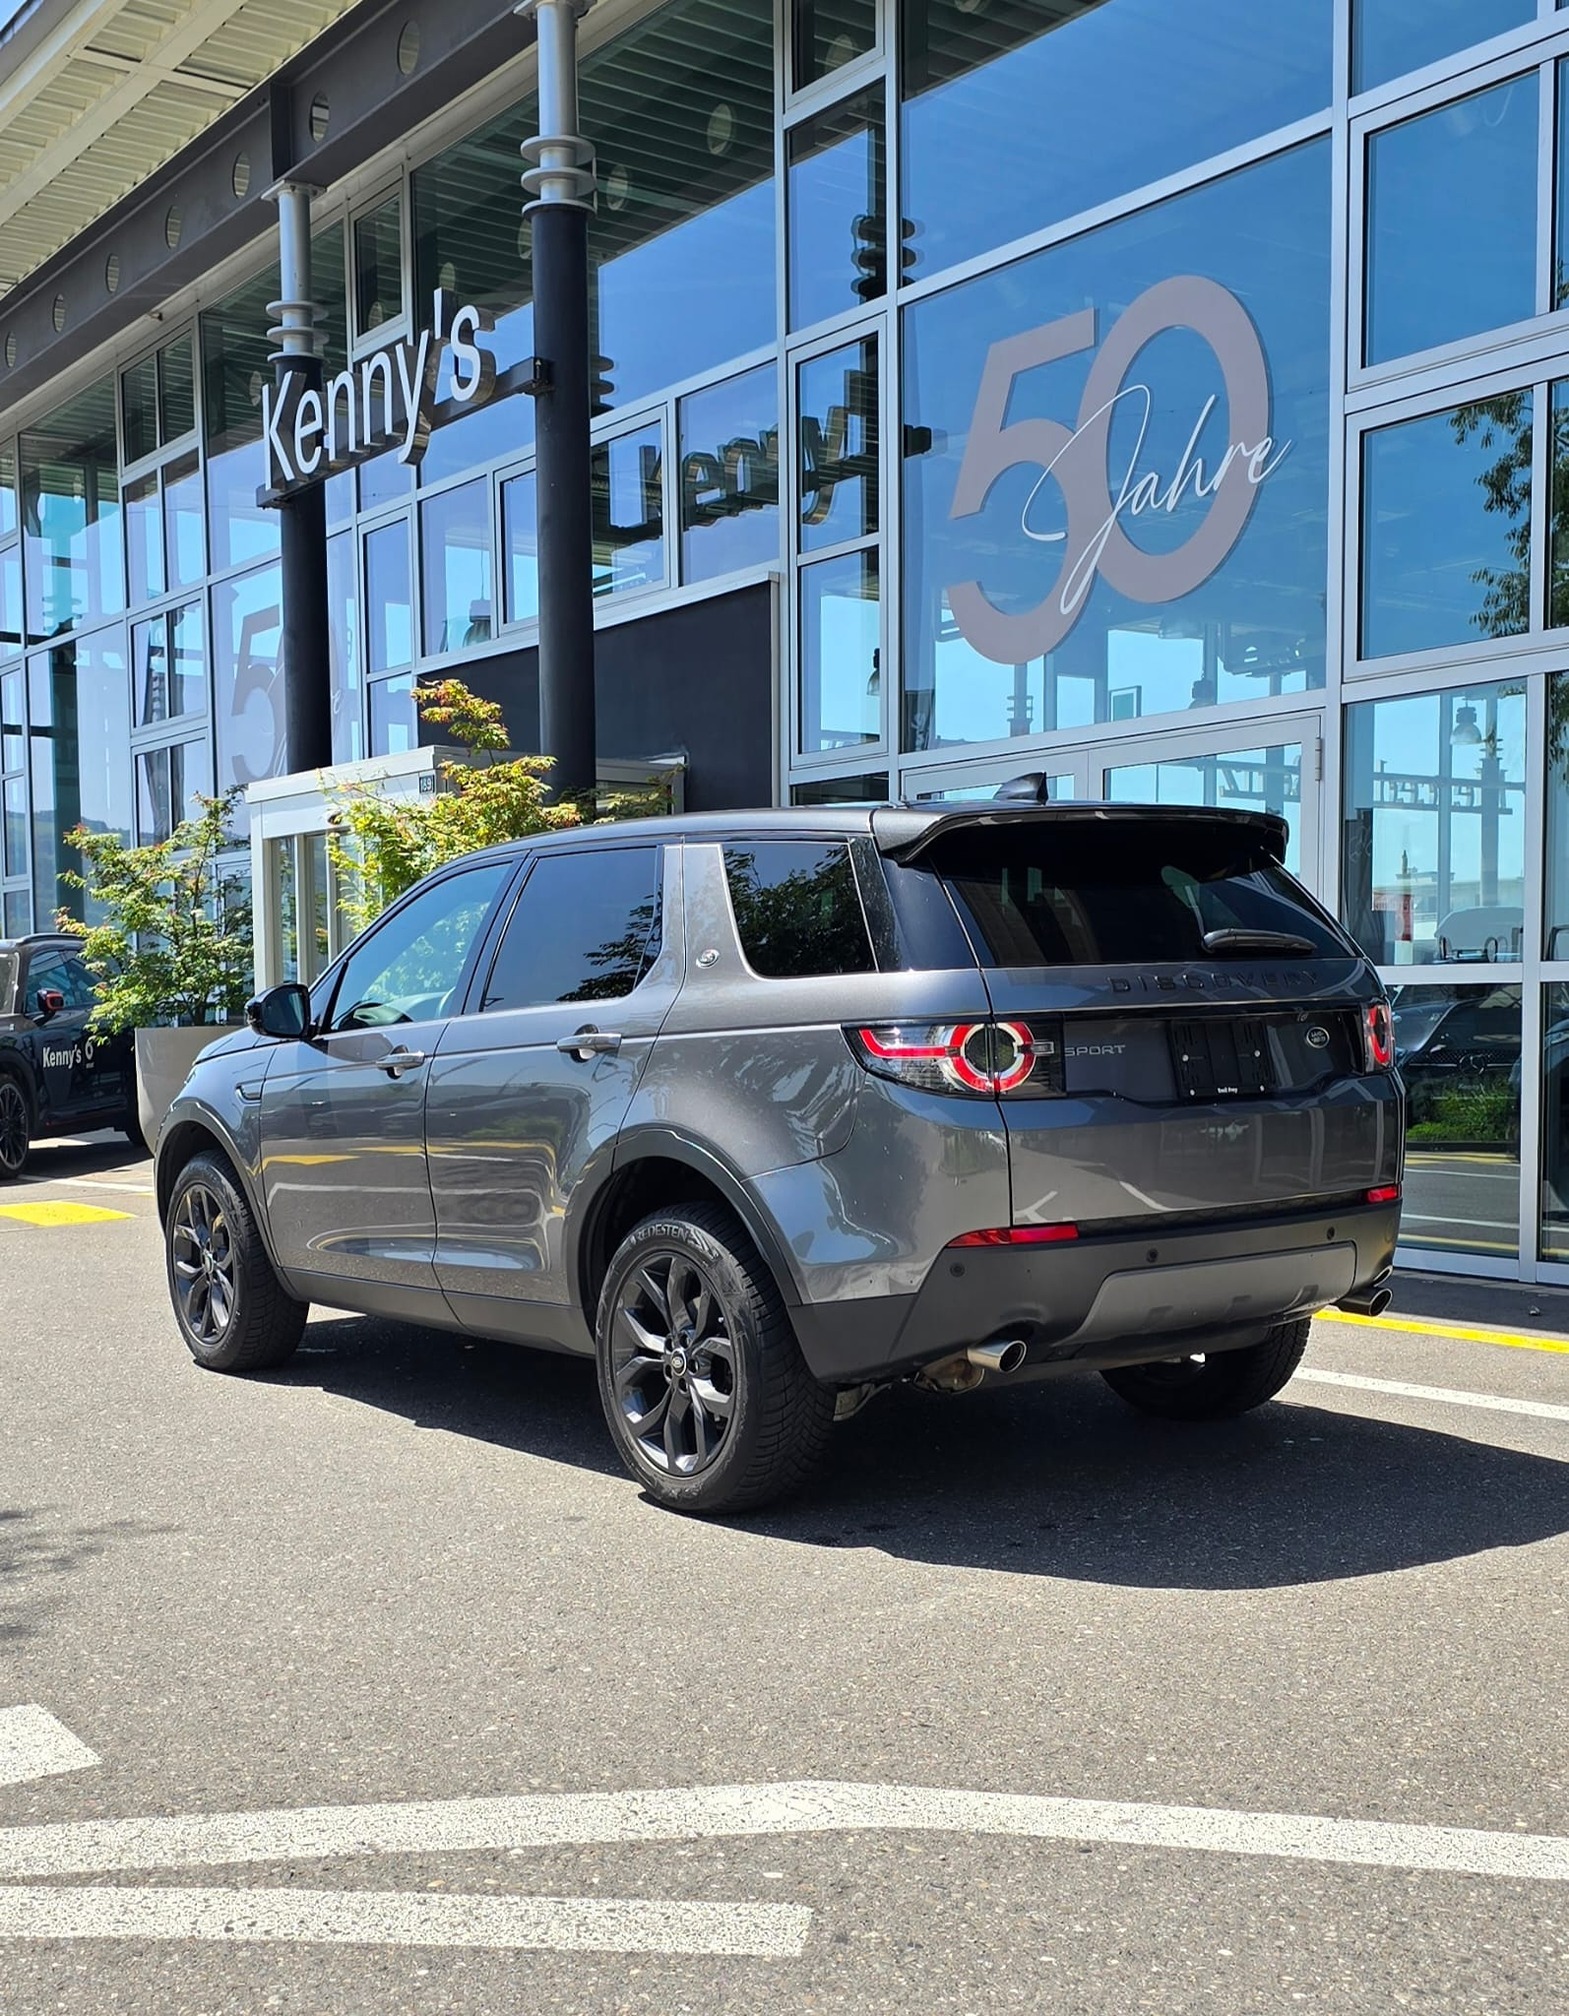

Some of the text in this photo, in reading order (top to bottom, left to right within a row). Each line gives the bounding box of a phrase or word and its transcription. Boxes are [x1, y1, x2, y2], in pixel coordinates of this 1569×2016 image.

[262, 287, 480, 491] Kenny's
[946, 275, 1271, 664] 50
[1022, 384, 1292, 615] Jahre
[1107, 971, 1318, 993] DISCOVERY
[43, 1044, 82, 1069] Kenny's
[1065, 1045, 1126, 1057] SPORT
